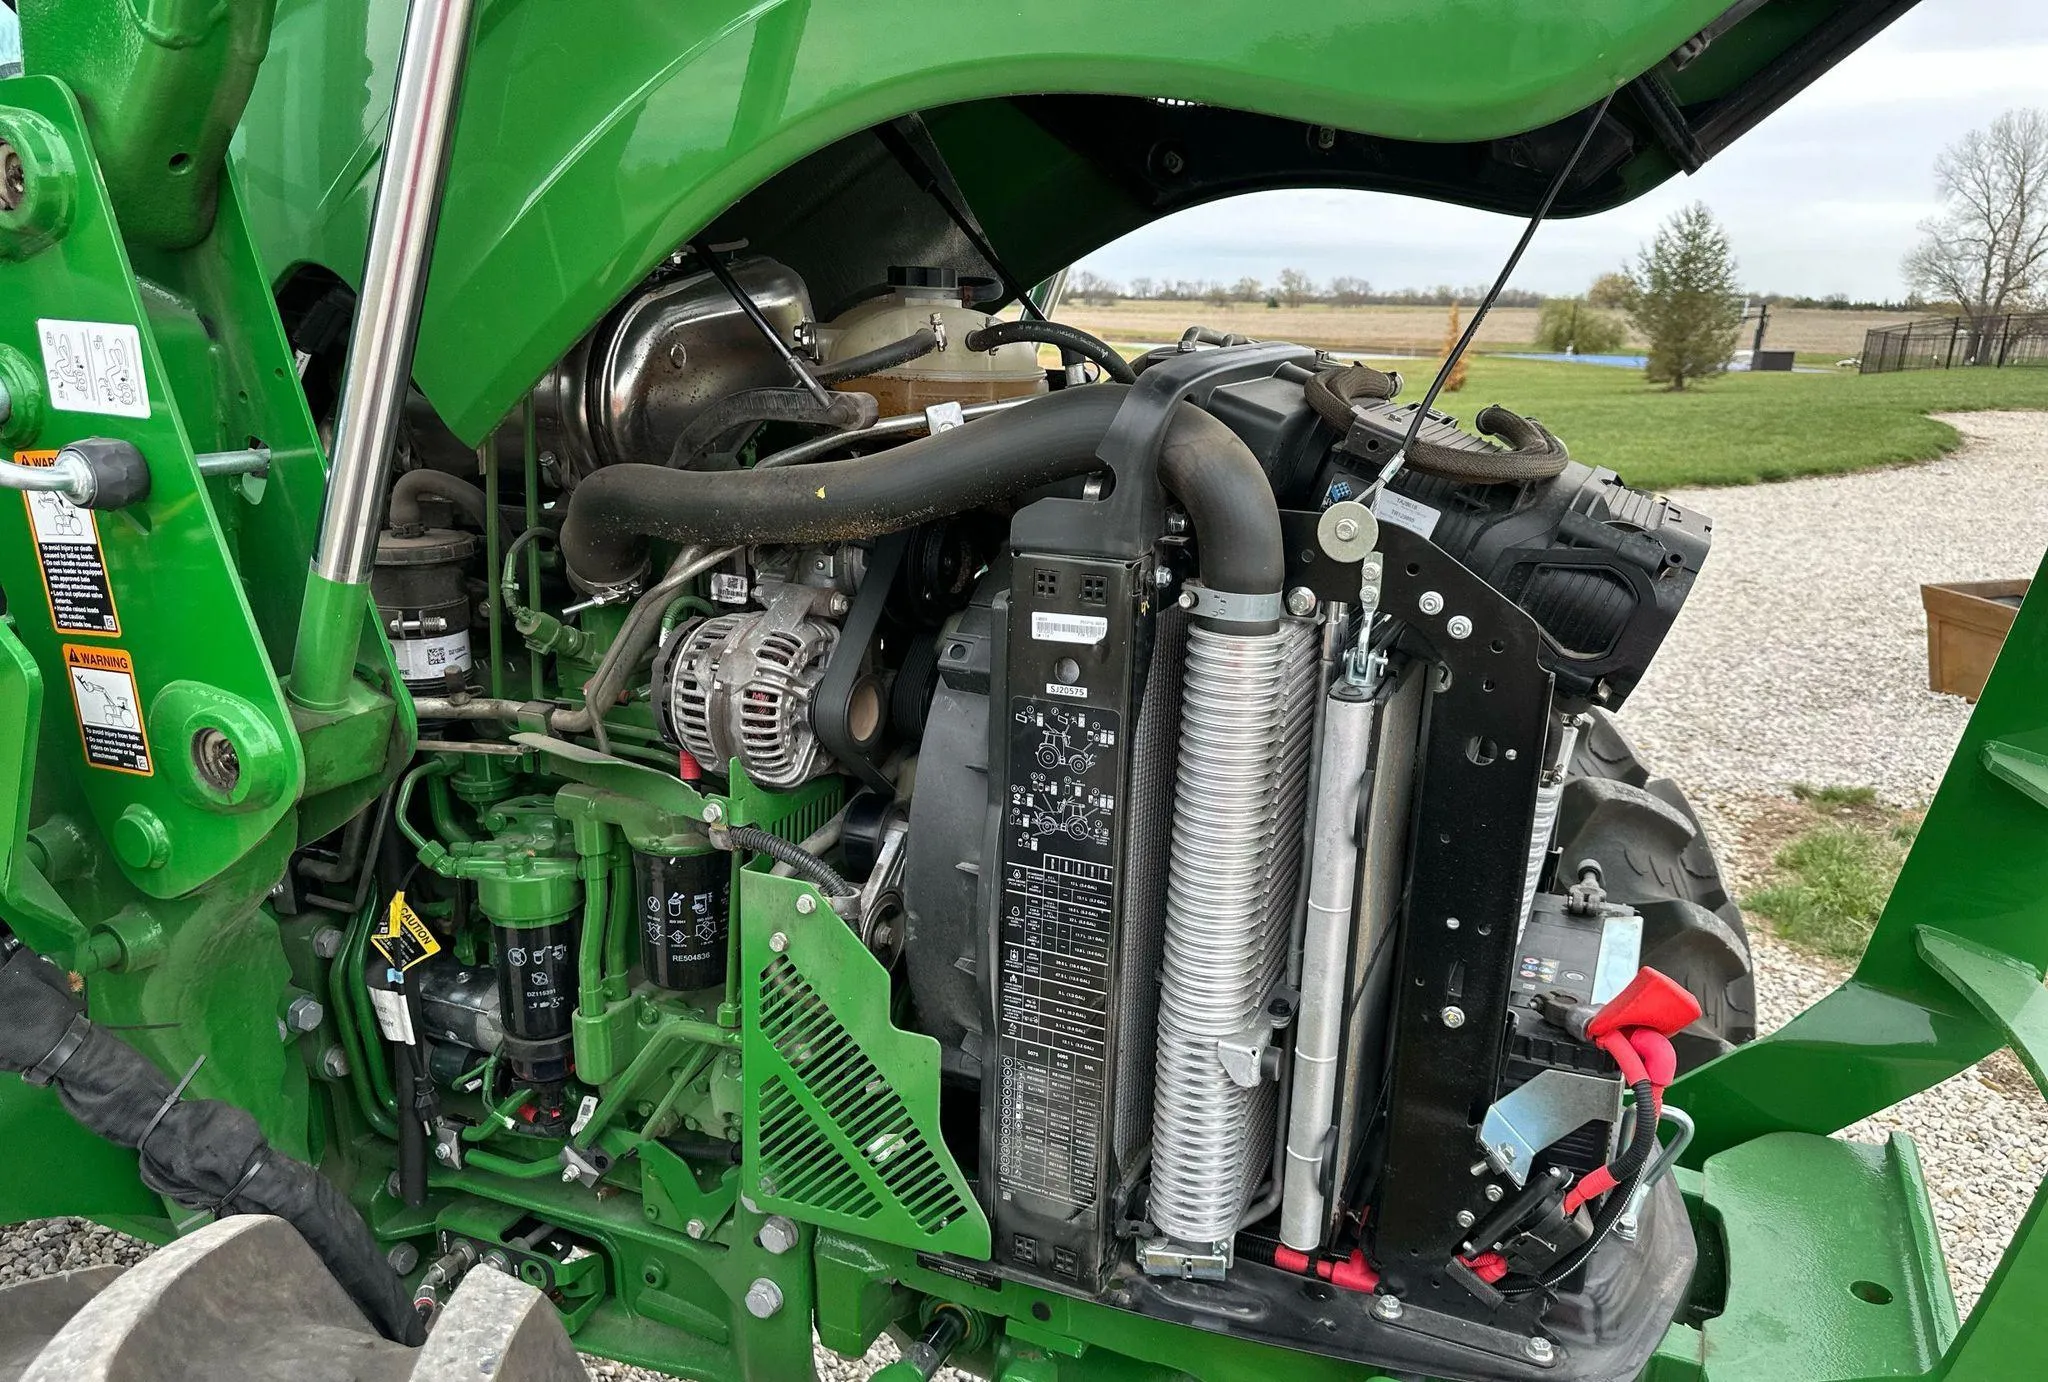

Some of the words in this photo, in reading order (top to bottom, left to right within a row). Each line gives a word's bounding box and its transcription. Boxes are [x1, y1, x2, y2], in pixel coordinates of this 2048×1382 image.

[81, 652, 128, 669] WARNING
[1050, 685, 1085, 696] SJ20575
[401, 907, 432, 945] CAUTION
[672, 952, 711, 962] RE504836
